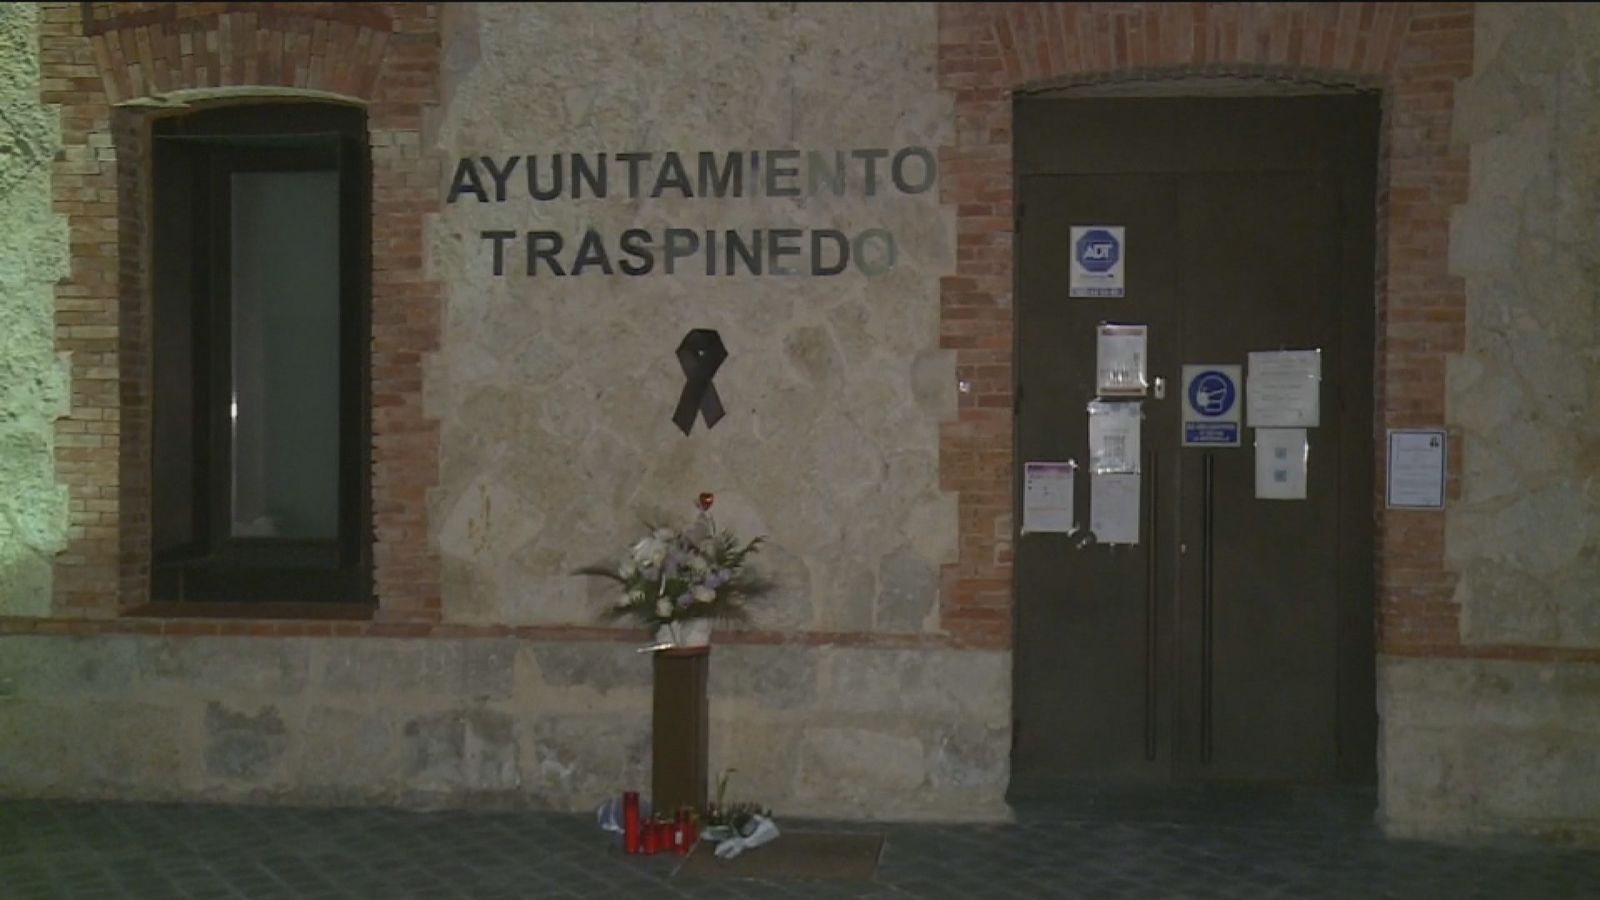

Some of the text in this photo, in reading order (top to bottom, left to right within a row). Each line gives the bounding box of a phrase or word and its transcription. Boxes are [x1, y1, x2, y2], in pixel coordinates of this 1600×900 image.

[447, 146, 937, 204] AYUNTAMIENTO
[480, 228, 895, 276] TRASPINEDO
[1082, 243, 1114, 260] ADT
